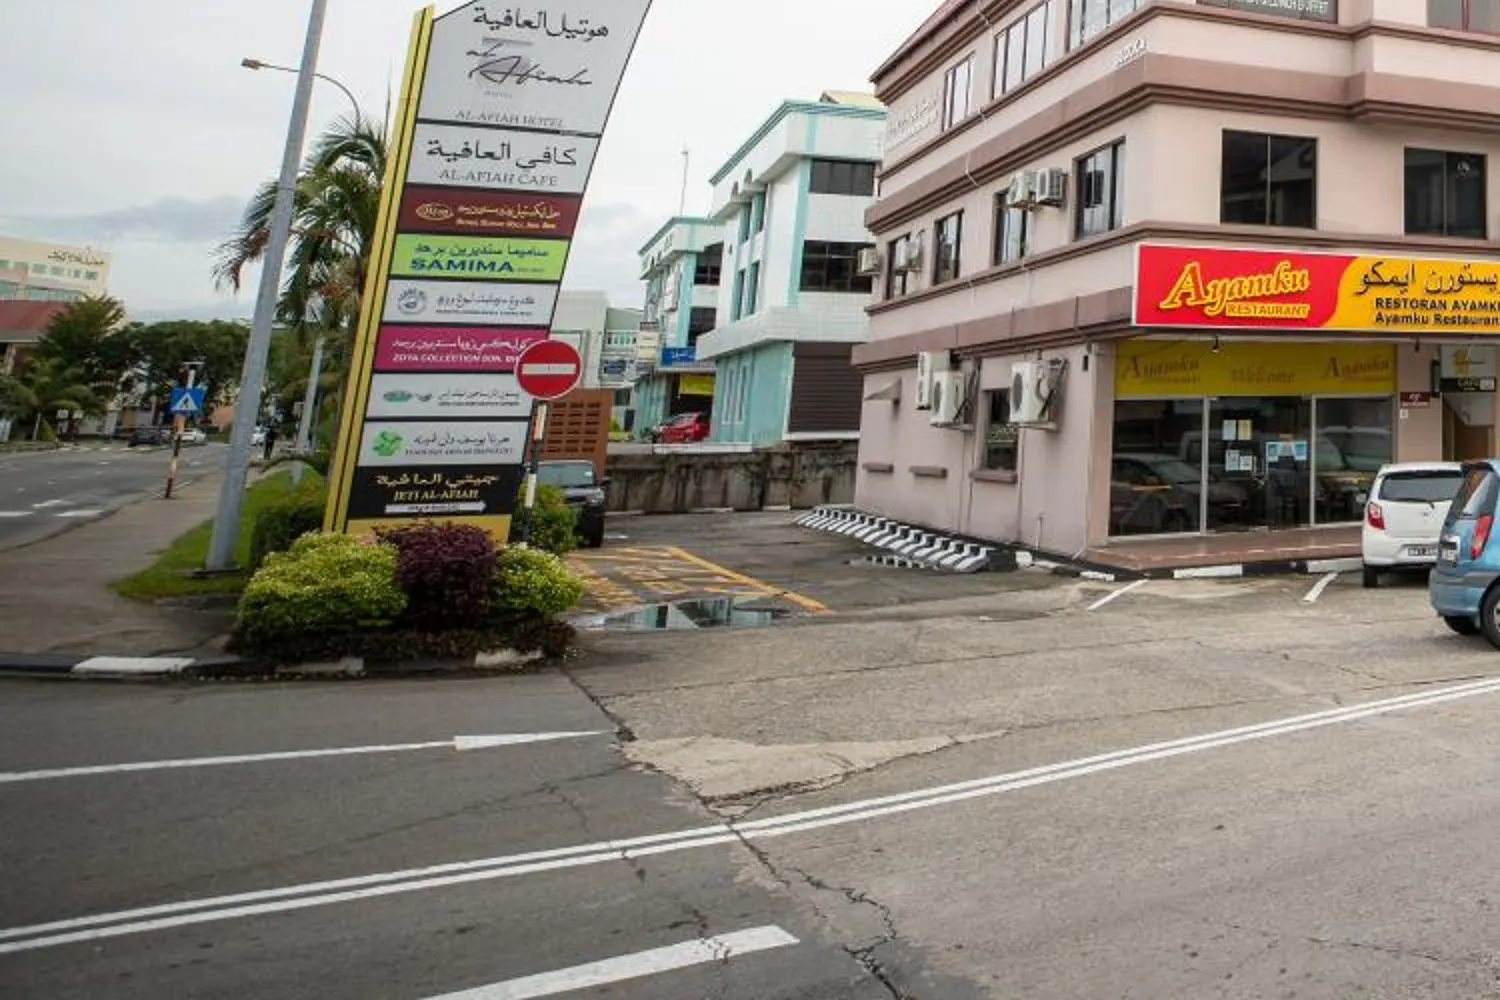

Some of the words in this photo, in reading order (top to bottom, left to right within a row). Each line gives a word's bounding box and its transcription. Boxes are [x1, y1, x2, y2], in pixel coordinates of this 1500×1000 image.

[473, 6, 547, 31] العافية
[546, 12, 609, 42] هوتيل
[426, 138, 512, 163] العافية
[439, 169, 514, 185] AL-AFIAH
[516, 173, 559, 187] CAFE
[410, 258, 514, 273] SAMIMA
[1159, 260, 1310, 316] Ayamku
[1226, 302, 1311, 318] RESTAURANT
[1375, 297, 1447, 311] RESTORAN
[1375, 312, 1429, 327] Ayamku
